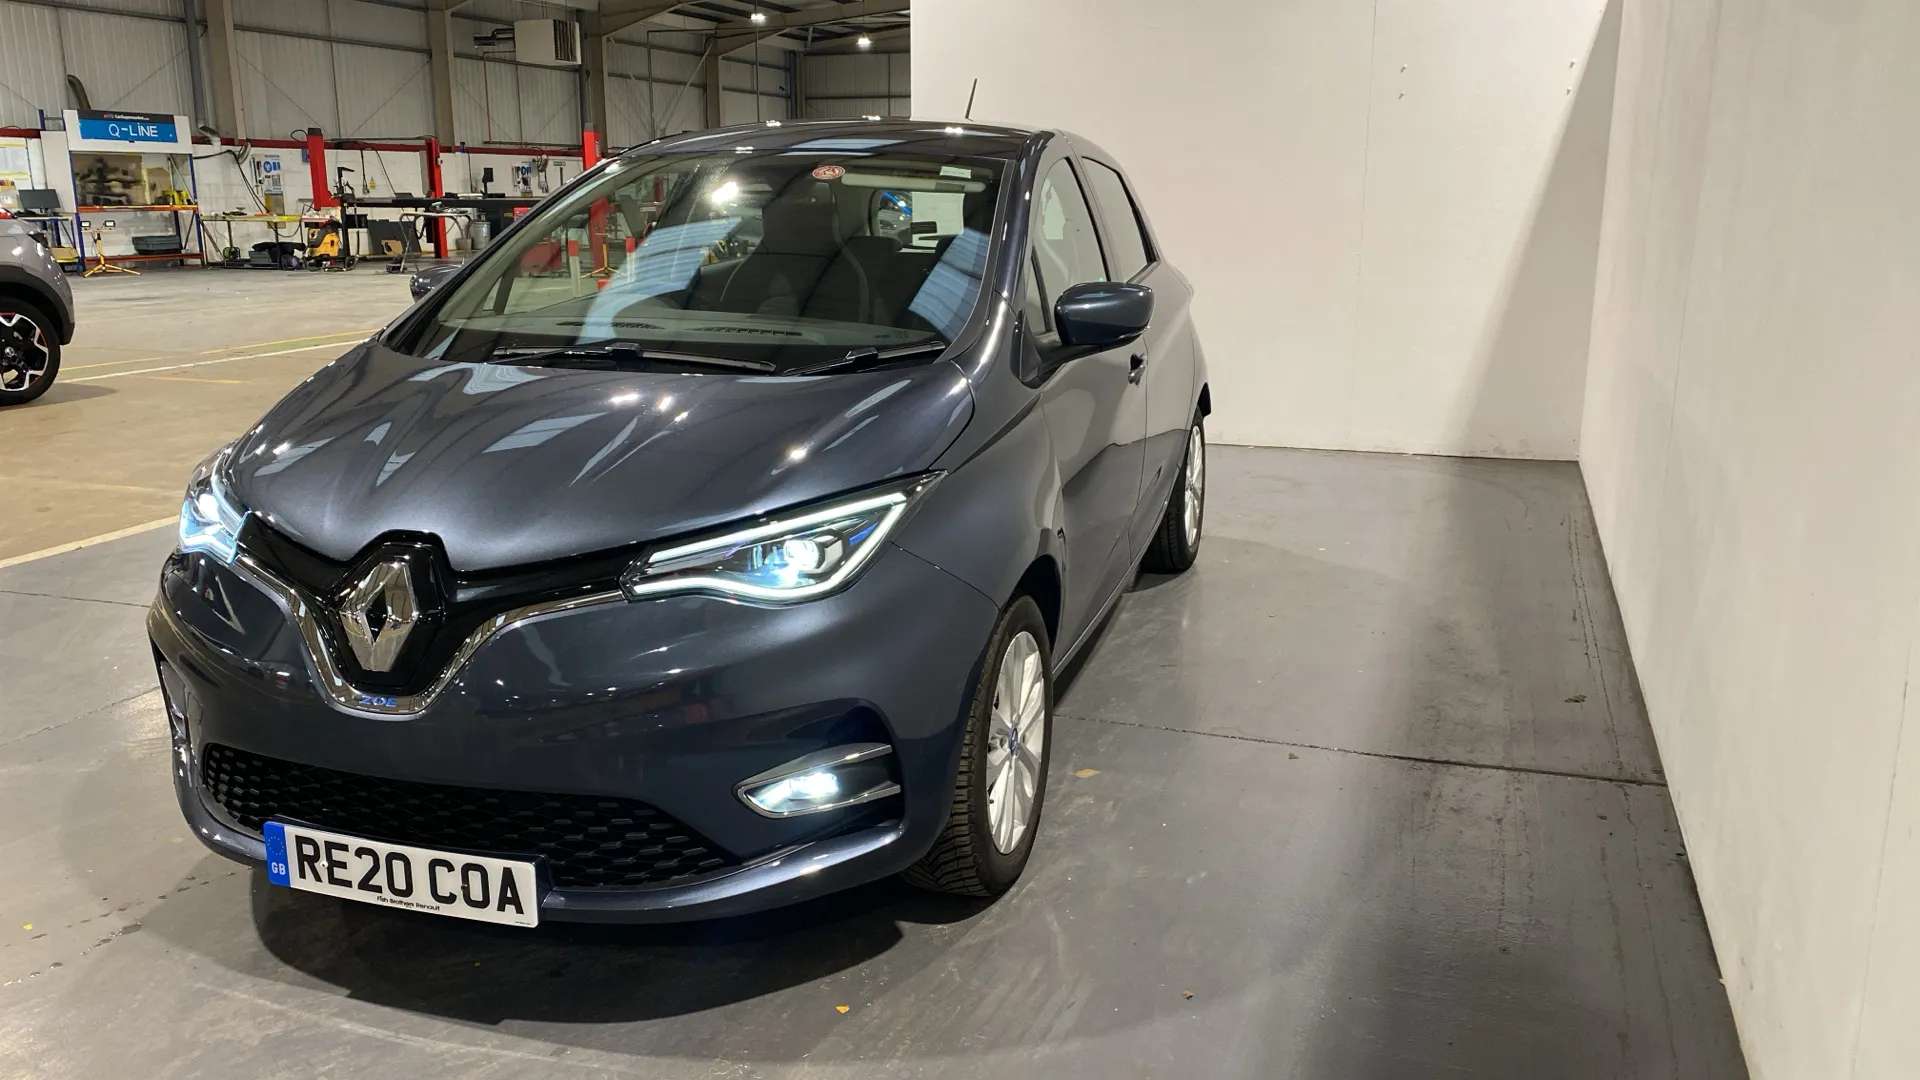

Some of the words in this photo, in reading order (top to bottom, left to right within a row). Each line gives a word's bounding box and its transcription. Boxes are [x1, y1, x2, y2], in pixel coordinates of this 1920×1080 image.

[359, 695, 398, 707] ZOE
[271, 862, 286, 876] GB
[294, 834, 414, 898] RE20
[428, 858, 525, 915] COA
